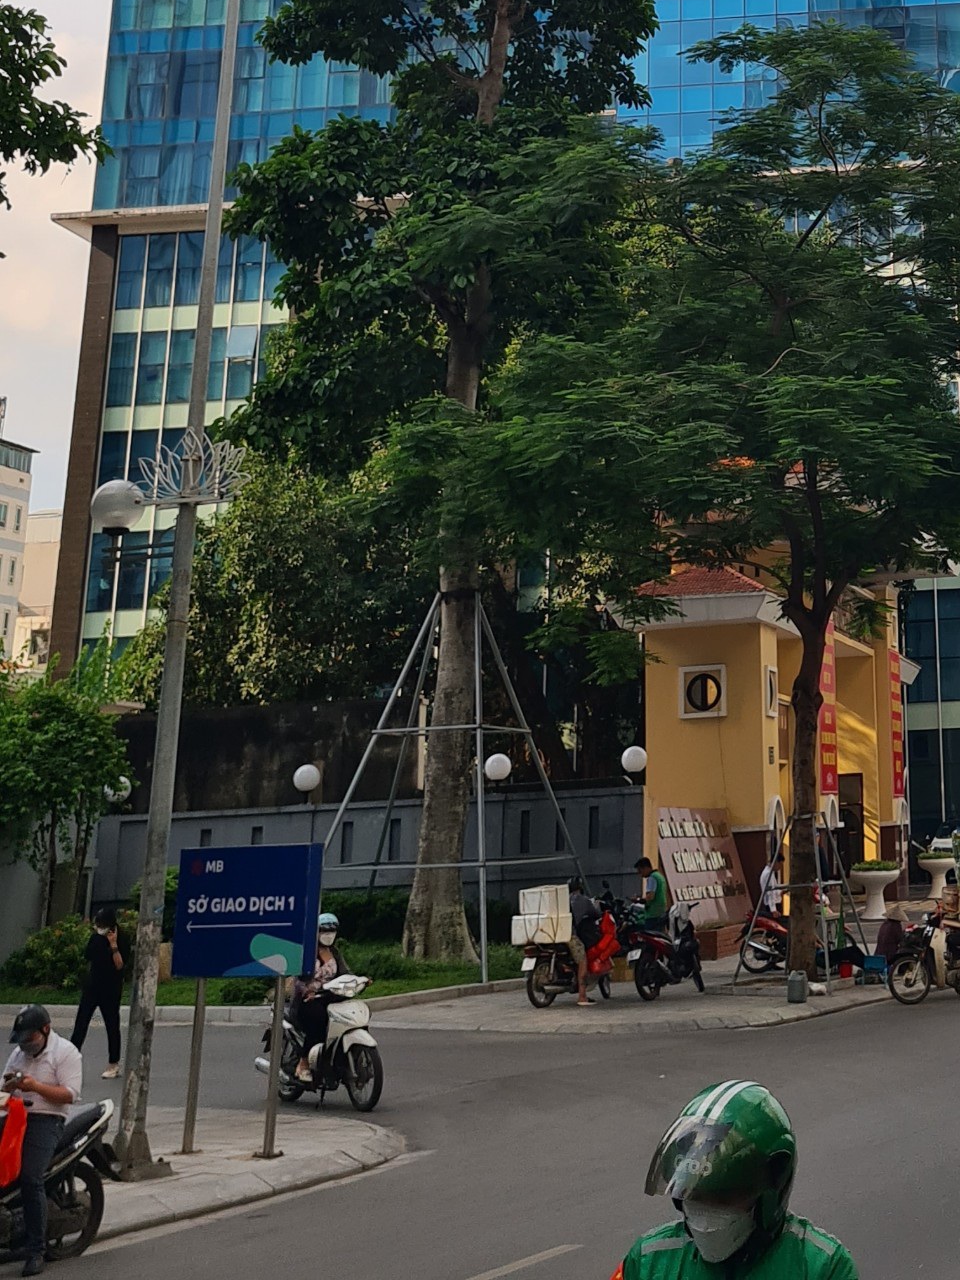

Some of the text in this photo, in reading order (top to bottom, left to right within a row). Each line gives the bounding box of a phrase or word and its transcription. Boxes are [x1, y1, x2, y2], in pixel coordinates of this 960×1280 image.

[205, 860, 224, 873] MB
[187, 894, 295, 916] SỞ GIAO DỊCH 1
